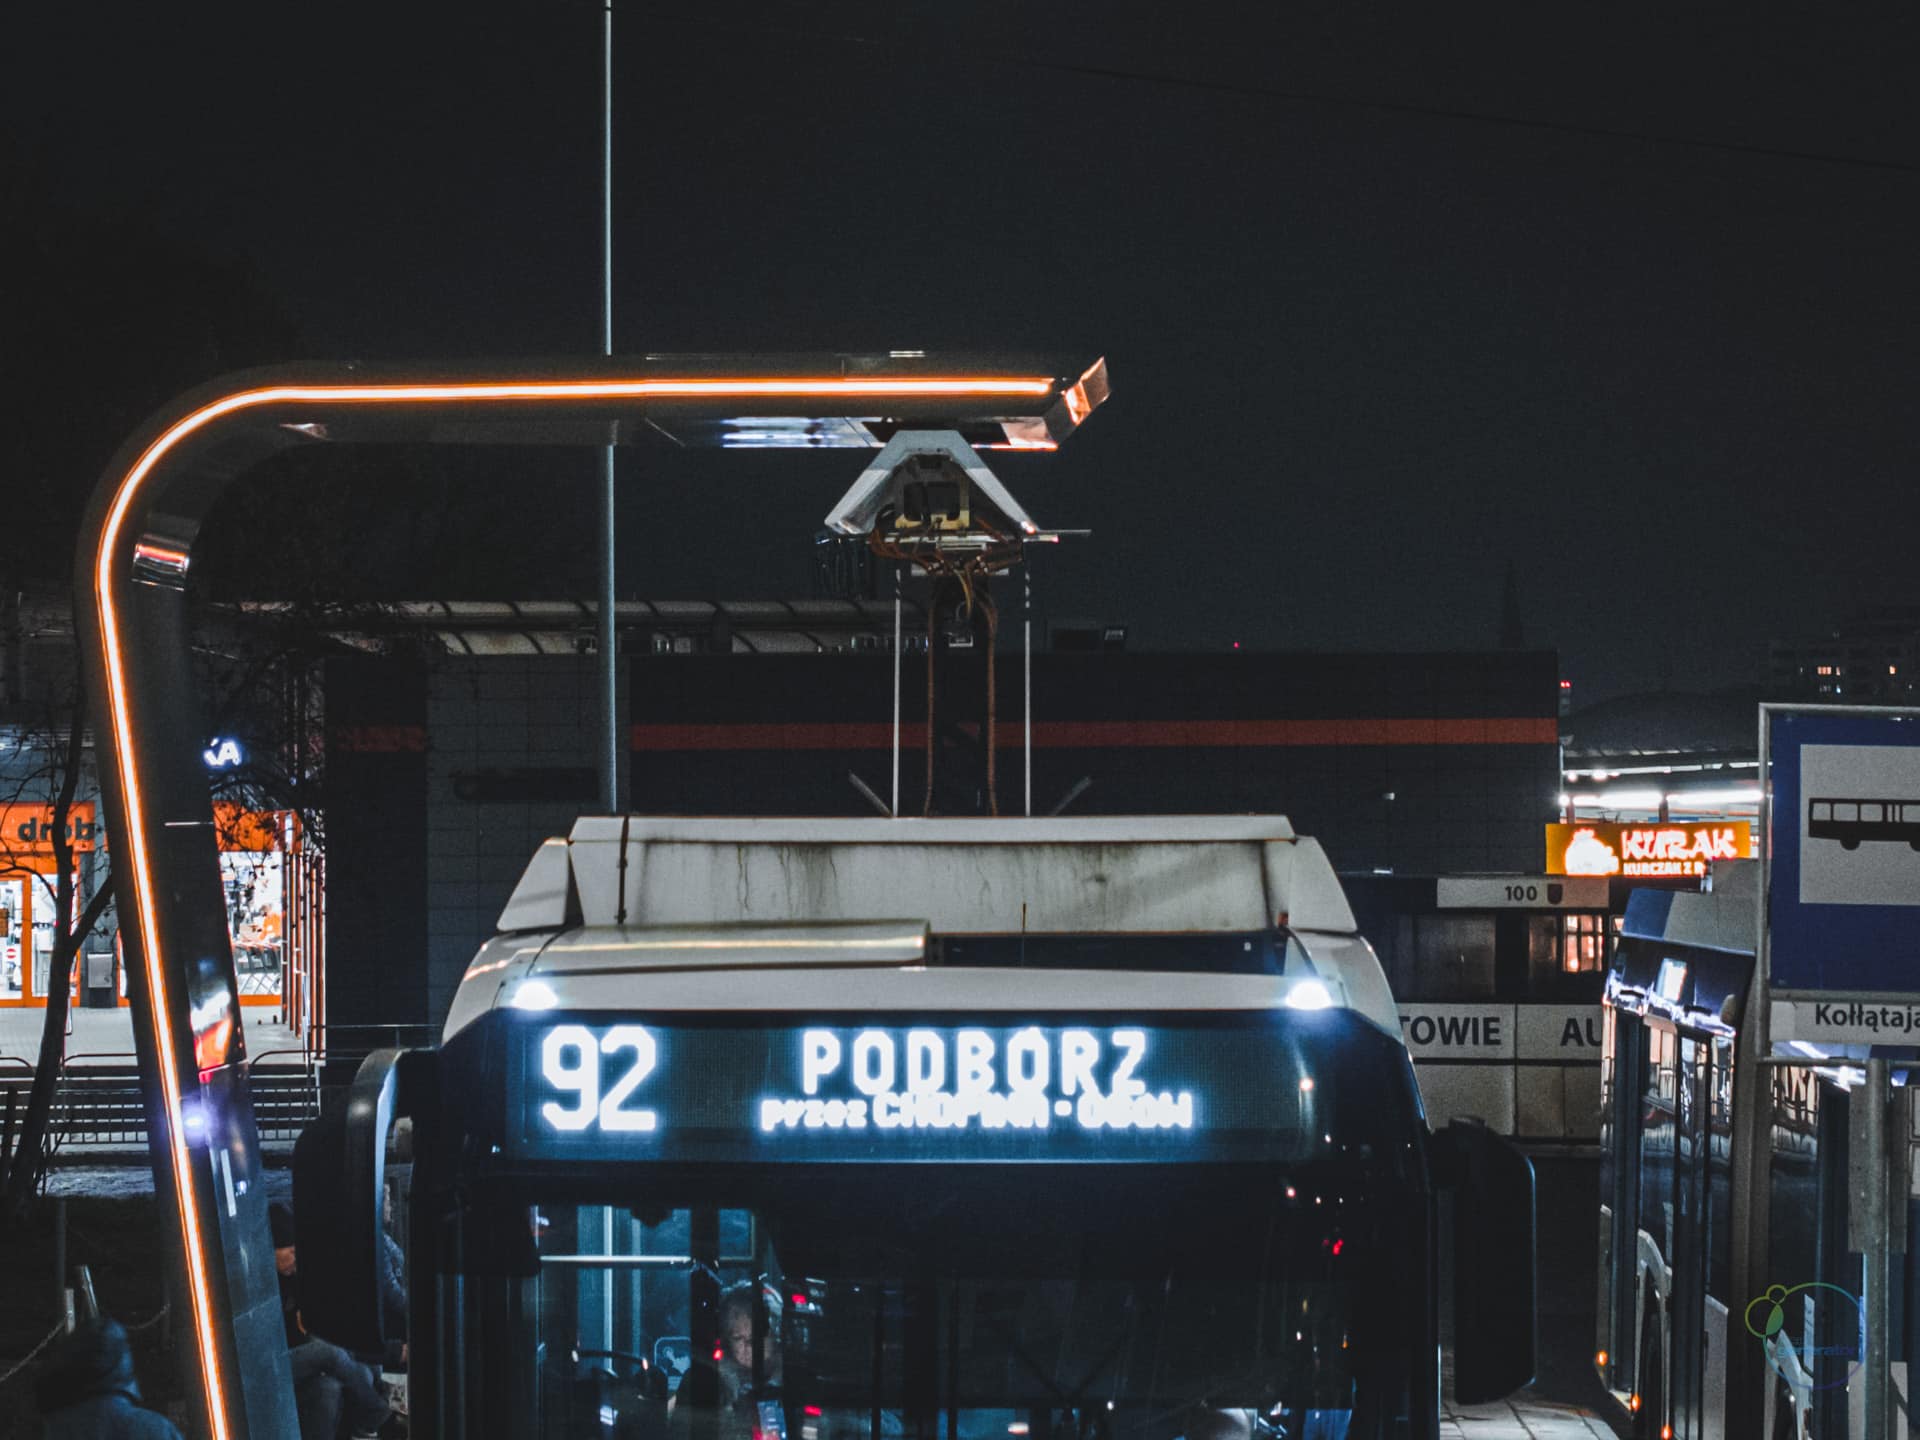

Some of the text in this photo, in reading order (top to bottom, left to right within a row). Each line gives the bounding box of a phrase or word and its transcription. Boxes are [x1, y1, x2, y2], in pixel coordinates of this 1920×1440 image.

[1621, 829, 1737, 860] KURAK
[1623, 862, 1682, 875] KURCZAK
[1683, 862, 1691, 875] Z
[1505, 885, 1537, 901] 100
[802, 1026, 1146, 1096] PODBÓRZ
[542, 1025, 657, 1131] 92
[761, 1099, 867, 1131] przez
